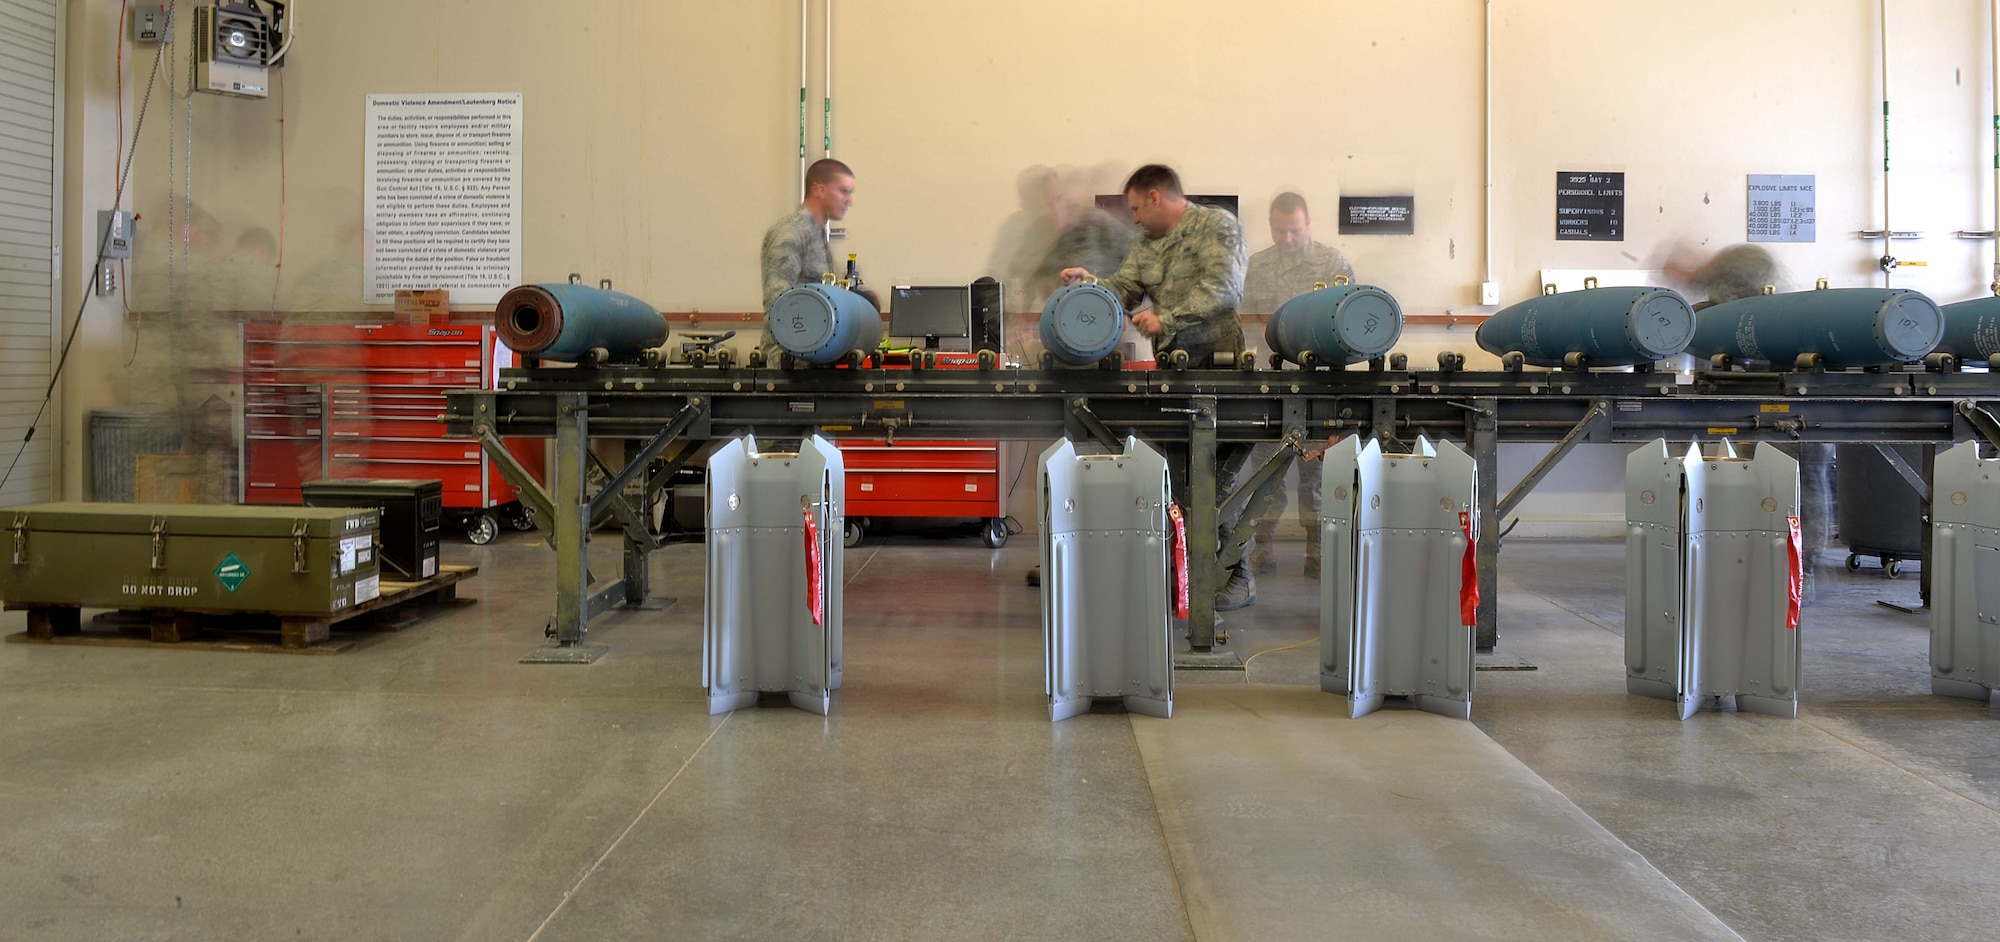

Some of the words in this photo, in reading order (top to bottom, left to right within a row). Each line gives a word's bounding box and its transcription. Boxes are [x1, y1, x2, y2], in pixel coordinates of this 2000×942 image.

[1899, 318, 1919, 329] 107
[122, 585, 137, 594] DO
[141, 585, 163, 595] NOT
[168, 586, 198, 596] DROP
